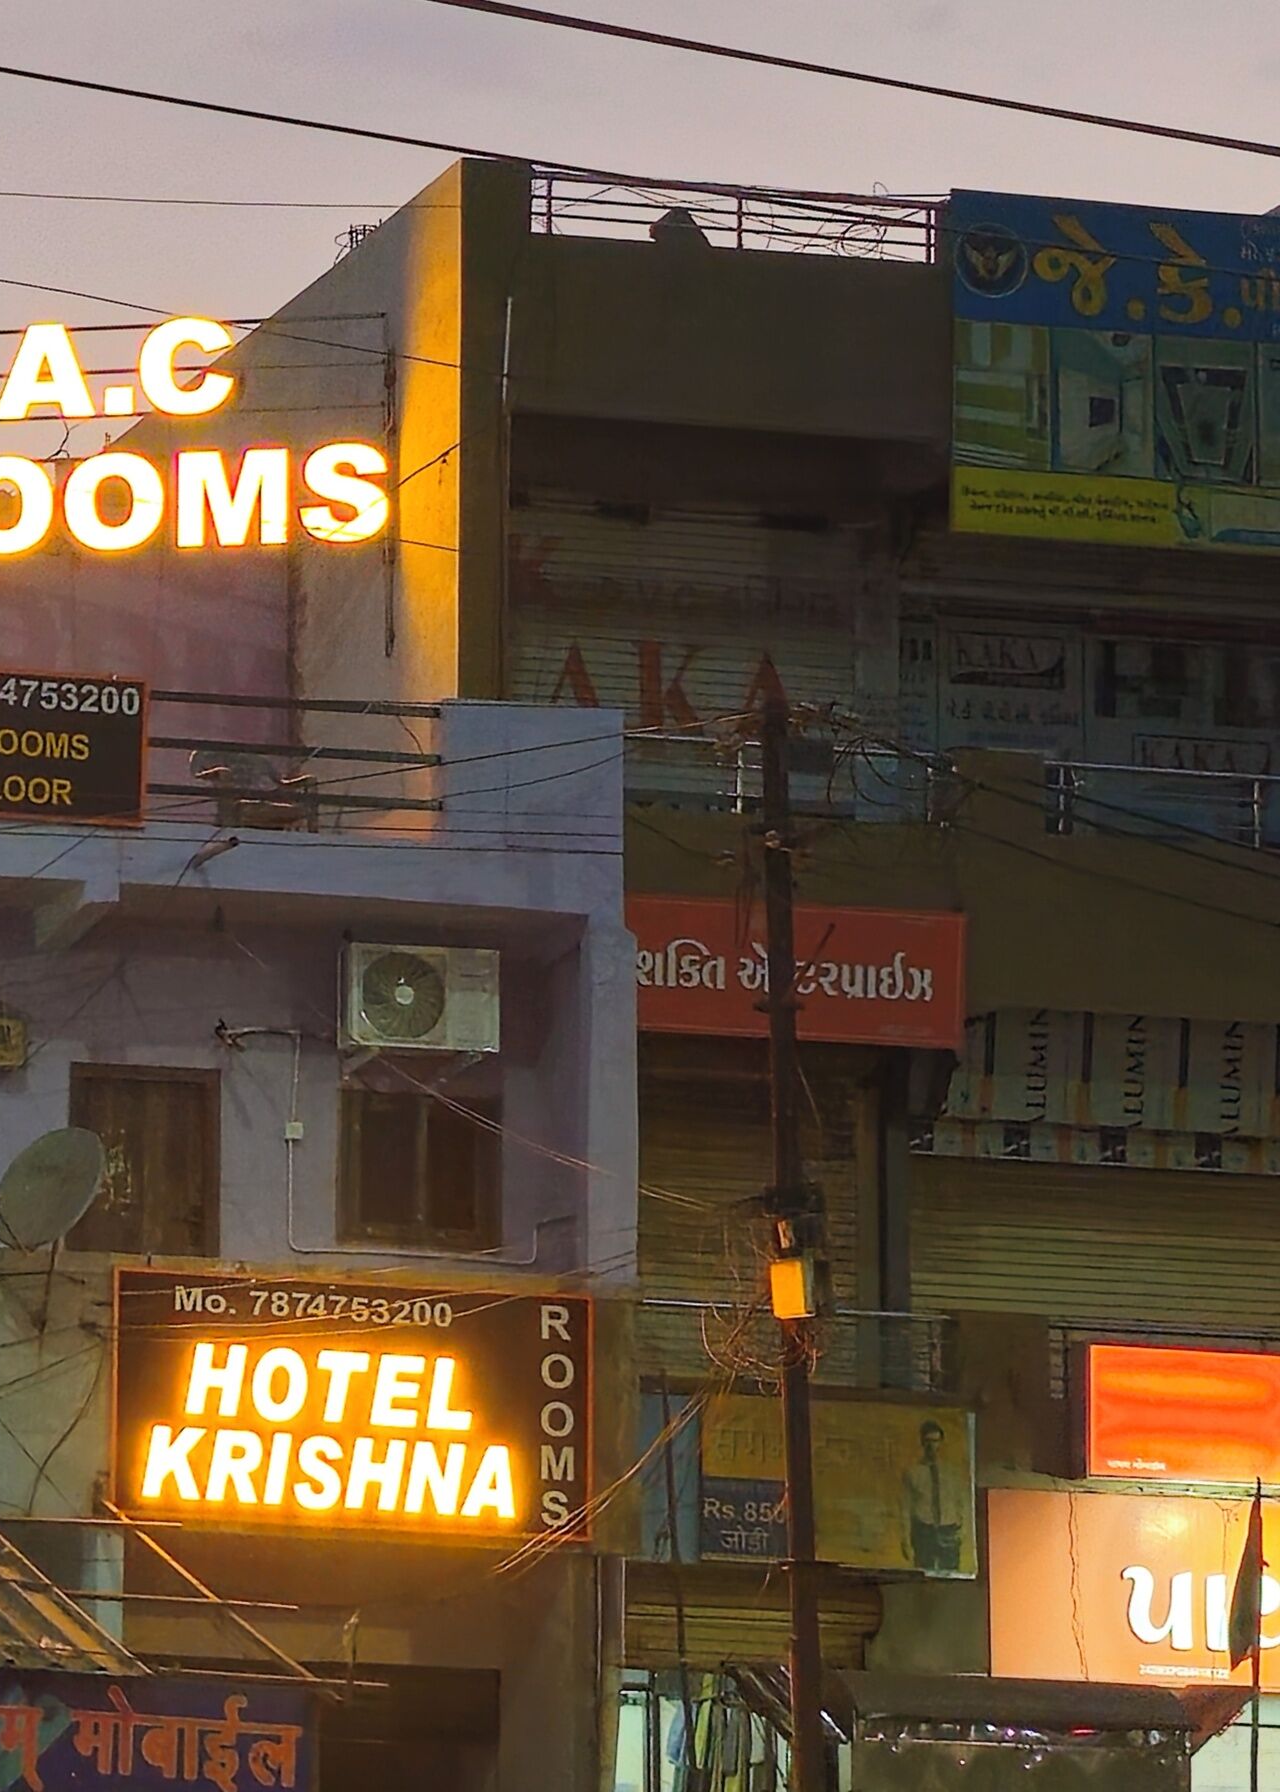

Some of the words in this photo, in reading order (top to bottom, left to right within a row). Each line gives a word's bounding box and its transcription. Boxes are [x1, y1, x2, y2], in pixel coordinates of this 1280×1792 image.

[174, 1285, 236, 1315] Mo.
[249, 1290, 453, 1329] 7874753200
[183, 1341, 474, 1432] HOTEL
[540, 1304, 576, 1529] ROOMS
[140, 1424, 518, 1520] KRISHNA
[69, 1684, 303, 1792] मोबाईल
